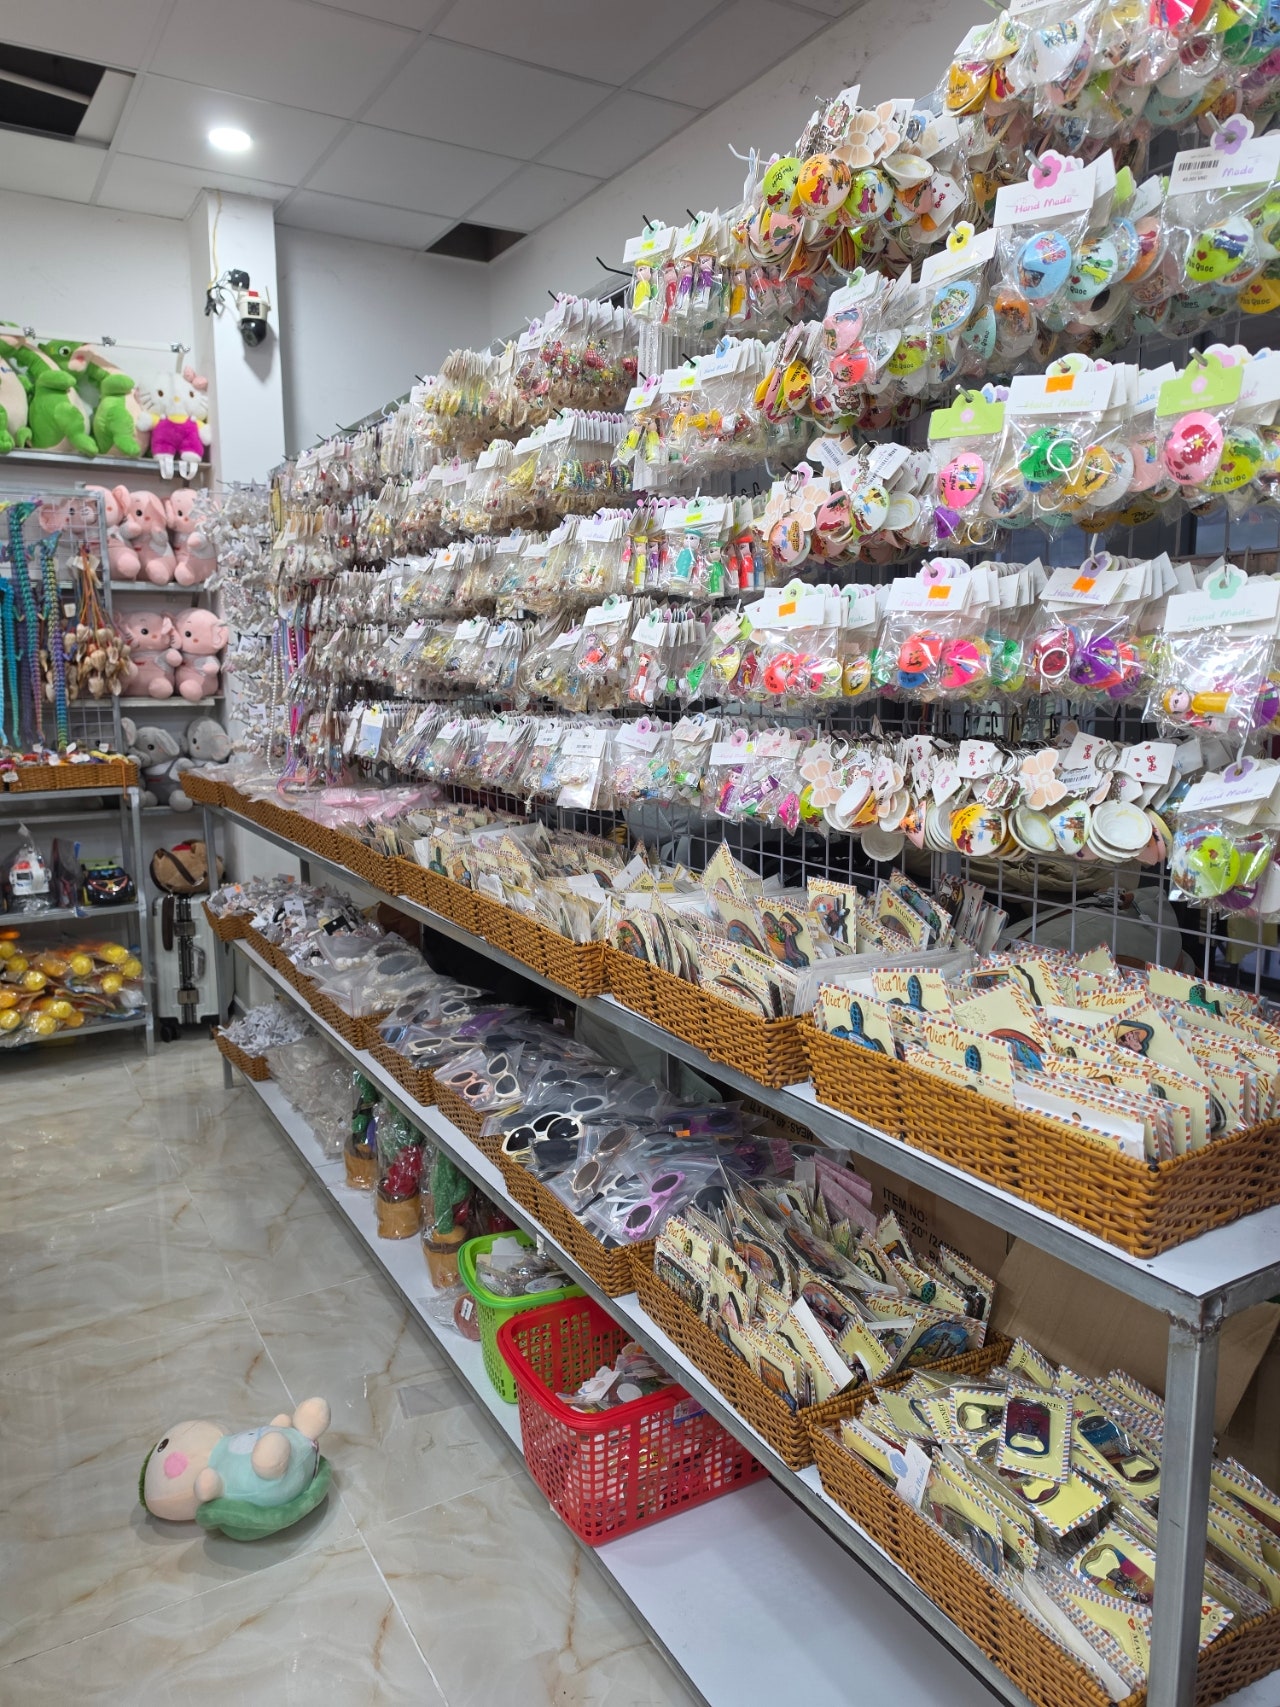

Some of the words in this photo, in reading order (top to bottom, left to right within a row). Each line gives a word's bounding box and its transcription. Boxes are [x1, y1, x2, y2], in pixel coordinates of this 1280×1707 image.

[1222, 165, 1255, 178] Made
[1014, 203, 1040, 214] Hand
[1044, 196, 1073, 208] Made
[1136, 393, 1156, 406] ade
[894, 903, 917, 928] MAGNET
[744, 946, 772, 967] Magnet
[874, 975, 892, 992] Viet
[893, 974, 908, 993] Na
[822, 989, 841, 1010] Viet
[1010, 986, 1032, 1018] Viet
[1092, 995, 1127, 1008] Nam
[926, 1025, 947, 1046] Viet
[1200, 1044, 1234, 1055] MAGNET
[910, 1052, 935, 1068] Viet
[939, 1060, 969, 1082] Nam
[1108, 1050, 1139, 1068] Viet
[1142, 1063, 1183, 1091] Nam
[1111, 1071, 1143, 1080] MAGNET
[1208, 1068, 1239, 1081] MAGNET
[883, 1187, 907, 1212] ITEM
[909, 1203, 928, 1227] NO:
[870, 1299, 891, 1313] Viet
